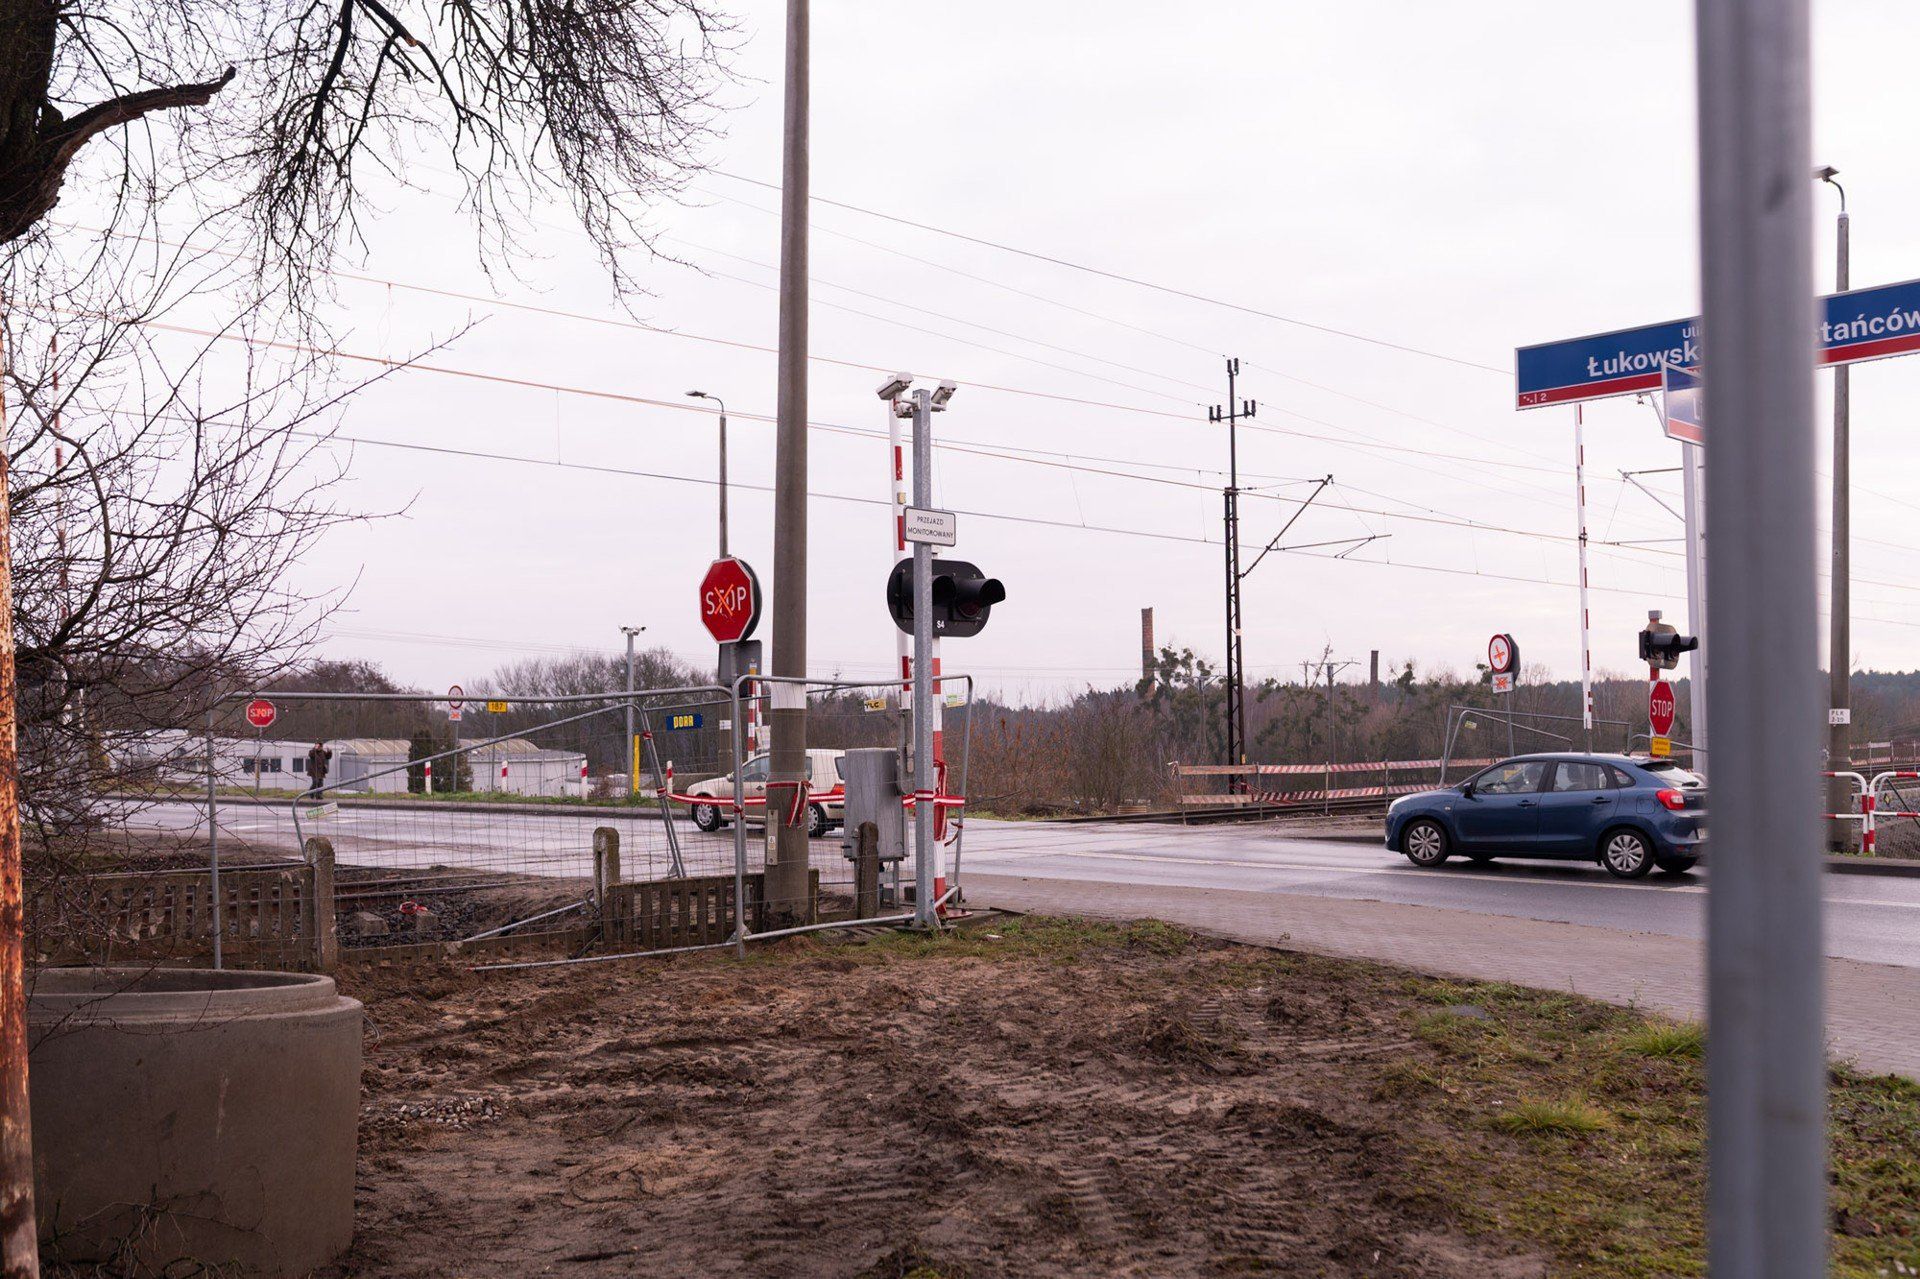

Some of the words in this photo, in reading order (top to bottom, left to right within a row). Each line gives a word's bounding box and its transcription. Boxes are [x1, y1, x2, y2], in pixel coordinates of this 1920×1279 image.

[1587, 340, 1700, 377] Łukowsk
[1818, 306, 1920, 343] tańców
[917, 515, 944, 526] PRZEJAZD
[907, 526, 953, 539] MONITOROWANY
[1652, 699, 1673, 718] STOP
